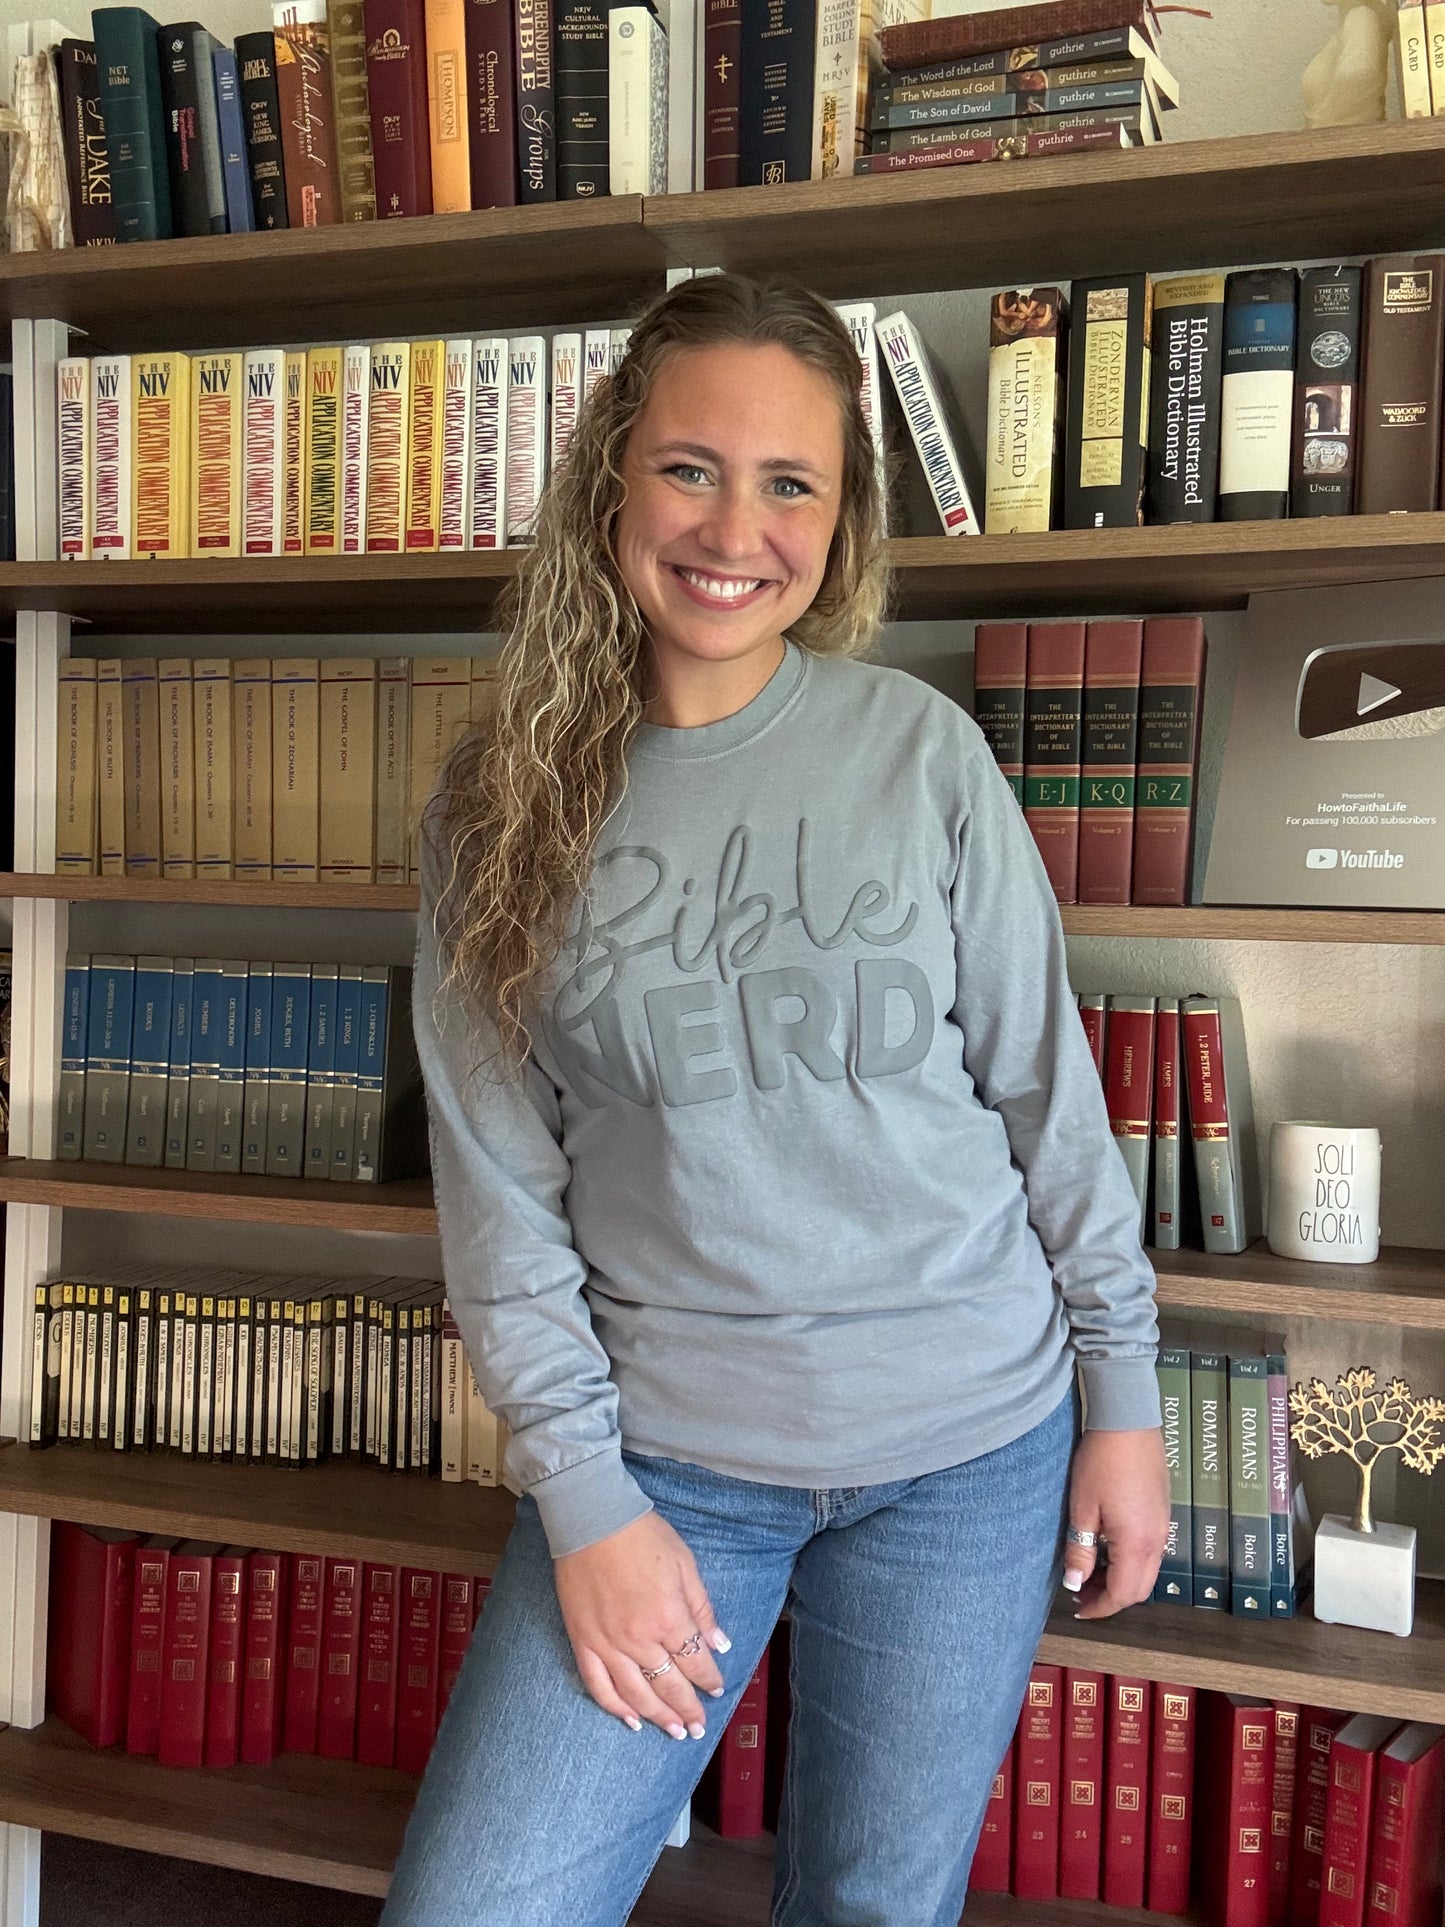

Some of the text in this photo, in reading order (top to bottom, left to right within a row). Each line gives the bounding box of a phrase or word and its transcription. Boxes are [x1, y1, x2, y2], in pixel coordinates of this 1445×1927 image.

[711, 0, 738, 10] BIBLE
[824, 9, 855, 22] COLLINS
[825, 1, 855, 13] HARPER
[761, 28, 792, 38] TESTAMENT
[823, 19, 853, 34] STUDY
[823, 30, 855, 47] BIBLE
[520, 0, 536, 91] BIBLE
[535, 0, 550, 88] ERENDIPITY
[1049, 41, 1085, 59] guthrie
[1407, 38, 1419, 71] CARD
[1434, 34, 1445, 68] CARD
[109, 66, 128, 75] NET
[243, 67, 271, 80] BIBLE
[245, 58, 266, 70] HOLY
[478, 53, 486, 92] STUDY
[823, 68, 850, 82] NRSV
[901, 59, 995, 87] The Word of the Lord
[1058, 69, 1097, 83] guthrie
[108, 76, 130, 86] Bible
[486, 50, 500, 133] Chronological
[902, 82, 995, 102] The Wisdom of God
[441, 57, 455, 136] THOMPSON
[1059, 91, 1095, 105] guthrie
[76, 95, 84, 141] ANNOTATED
[253, 113, 268, 121] NEW
[909, 102, 991, 120] The Son of David
[1059, 116, 1095, 130] guthrie
[253, 121, 270, 129] KING
[911, 127, 992, 145] The Lamb of God
[179, 108, 188, 171] Transformation
[251, 135, 277, 144] VERSION
[521, 104, 552, 190] Groups
[1038, 133, 1074, 148] guthrie
[87, 135, 111, 205] DAKE
[888, 147, 975, 167] The Promised One
[1166, 285, 1196, 293] REVISED
[1170, 291, 1208, 299] EXPANDED
[886, 335, 910, 365] NIV
[1228, 345, 1290, 356] BIBLE DICTIONARY
[61, 376, 83, 399] NIV
[139, 373, 169, 396] NIV
[200, 370, 230, 393] NIV
[314, 371, 336, 394] NIV
[1087, 331, 1098, 428] BIBLE DICTIONARY
[1096, 331, 1110, 428] ILLUSTRATED
[1108, 330, 1123, 427] ZONDERVAN
[1033, 375, 1042, 427] NELSON'S
[1161, 320, 1188, 480] Bible Dictionary
[1184, 317, 1208, 505] Holman Illustrated
[995, 379, 1011, 466] Bible Dictionary
[1012, 350, 1032, 478] ILLUSTRATED
[894, 361, 964, 511] APPLICATION COMMENTARY
[61, 401, 83, 539] APPLICATION COMMENTARY
[138, 398, 170, 537] APPLICATION COMMENTARY
[198, 394, 230, 535] APPLICATION COMMENTARY
[310, 395, 336, 534] APPLICATION COMMENTARY
[1309, 483, 1341, 493] UNGER
[1030, 713, 1080, 721] INTERPRETER'S
[1039, 783, 1066, 804] E-J
[1091, 783, 1125, 804] K-Q
[1147, 783, 1181, 800] R-Z
[1286, 815, 1436, 827] For passing 100,000 subscribers
[1317, 802, 1406, 813] HowtoFaithaLife
[1340, 850, 1404, 869] YouTube
[553, 817, 919, 1031] Bible
[541, 958, 935, 1109] NERD
[1123, 1045, 1133, 1088] HEBREWS
[1163, 1061, 1171, 1088] JAMES
[1201, 1050, 1210, 1080] PETER,
[1203, 1081, 1212, 1104] JUDE
[1315, 1144, 1353, 1175] SOLI
[1316, 1178, 1350, 1209] DEO
[1299, 1211, 1363, 1244] GLORIA
[1164, 1397, 1179, 1469] ROMANS
[1202, 1400, 1217, 1472] ROMANS
[1241, 1407, 1257, 1480] ROMANS
[1271, 1397, 1288, 1488] PHILIPPIANS
[1168, 1521, 1178, 1556] Boice
[1205, 1525, 1216, 1560] Boice
[1244, 1534, 1256, 1569] Boice
[1276, 1533, 1287, 1565] Boice
[1075, 1830, 1087, 1839] 24
[1244, 1880, 1255, 1888] 27
